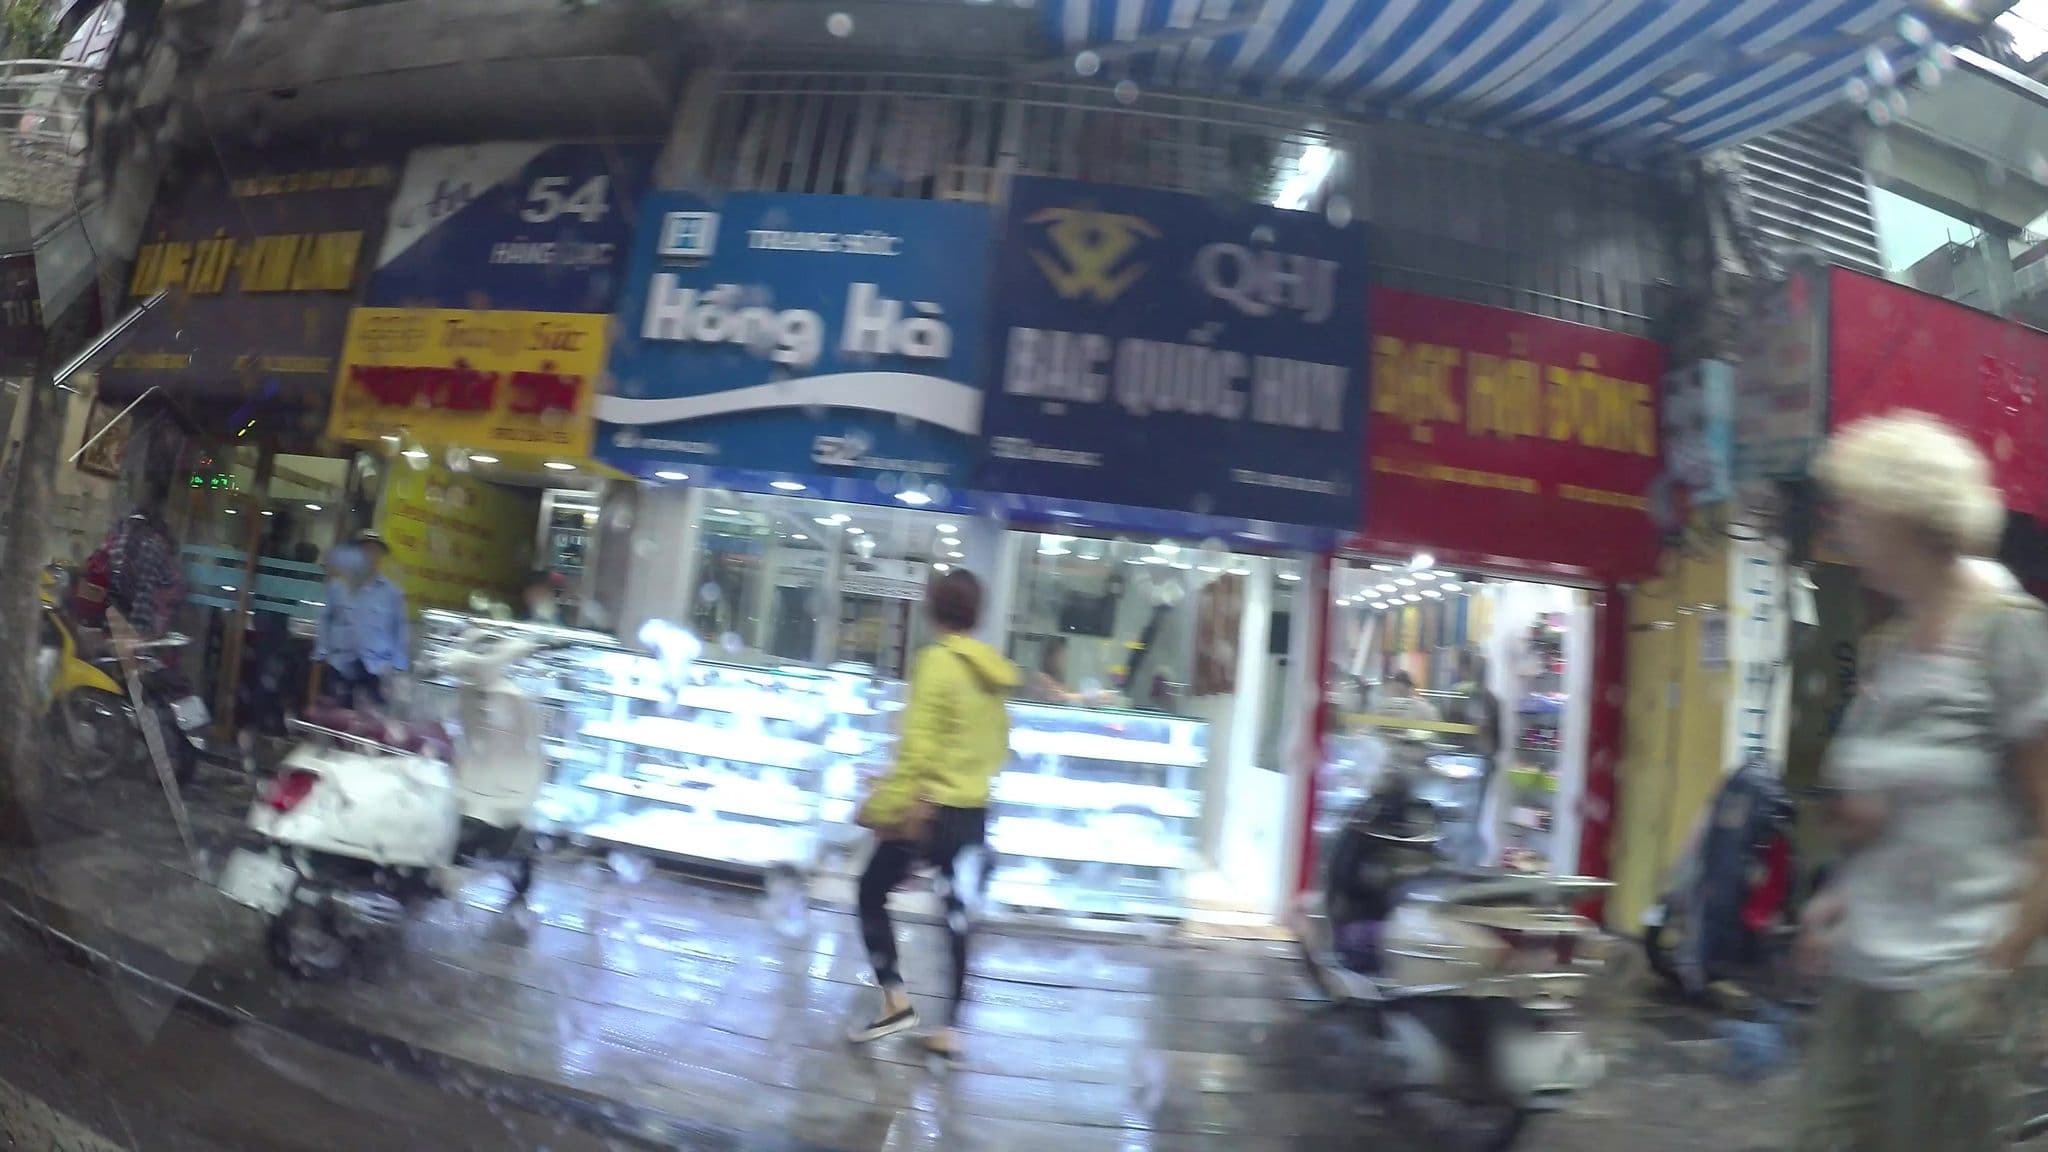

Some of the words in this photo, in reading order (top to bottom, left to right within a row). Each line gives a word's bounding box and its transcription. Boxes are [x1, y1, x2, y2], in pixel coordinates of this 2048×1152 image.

[520, 174, 610, 222] 54
[1003, 327, 1111, 416] BẠC
[1113, 320, 1248, 421] QUỐC
